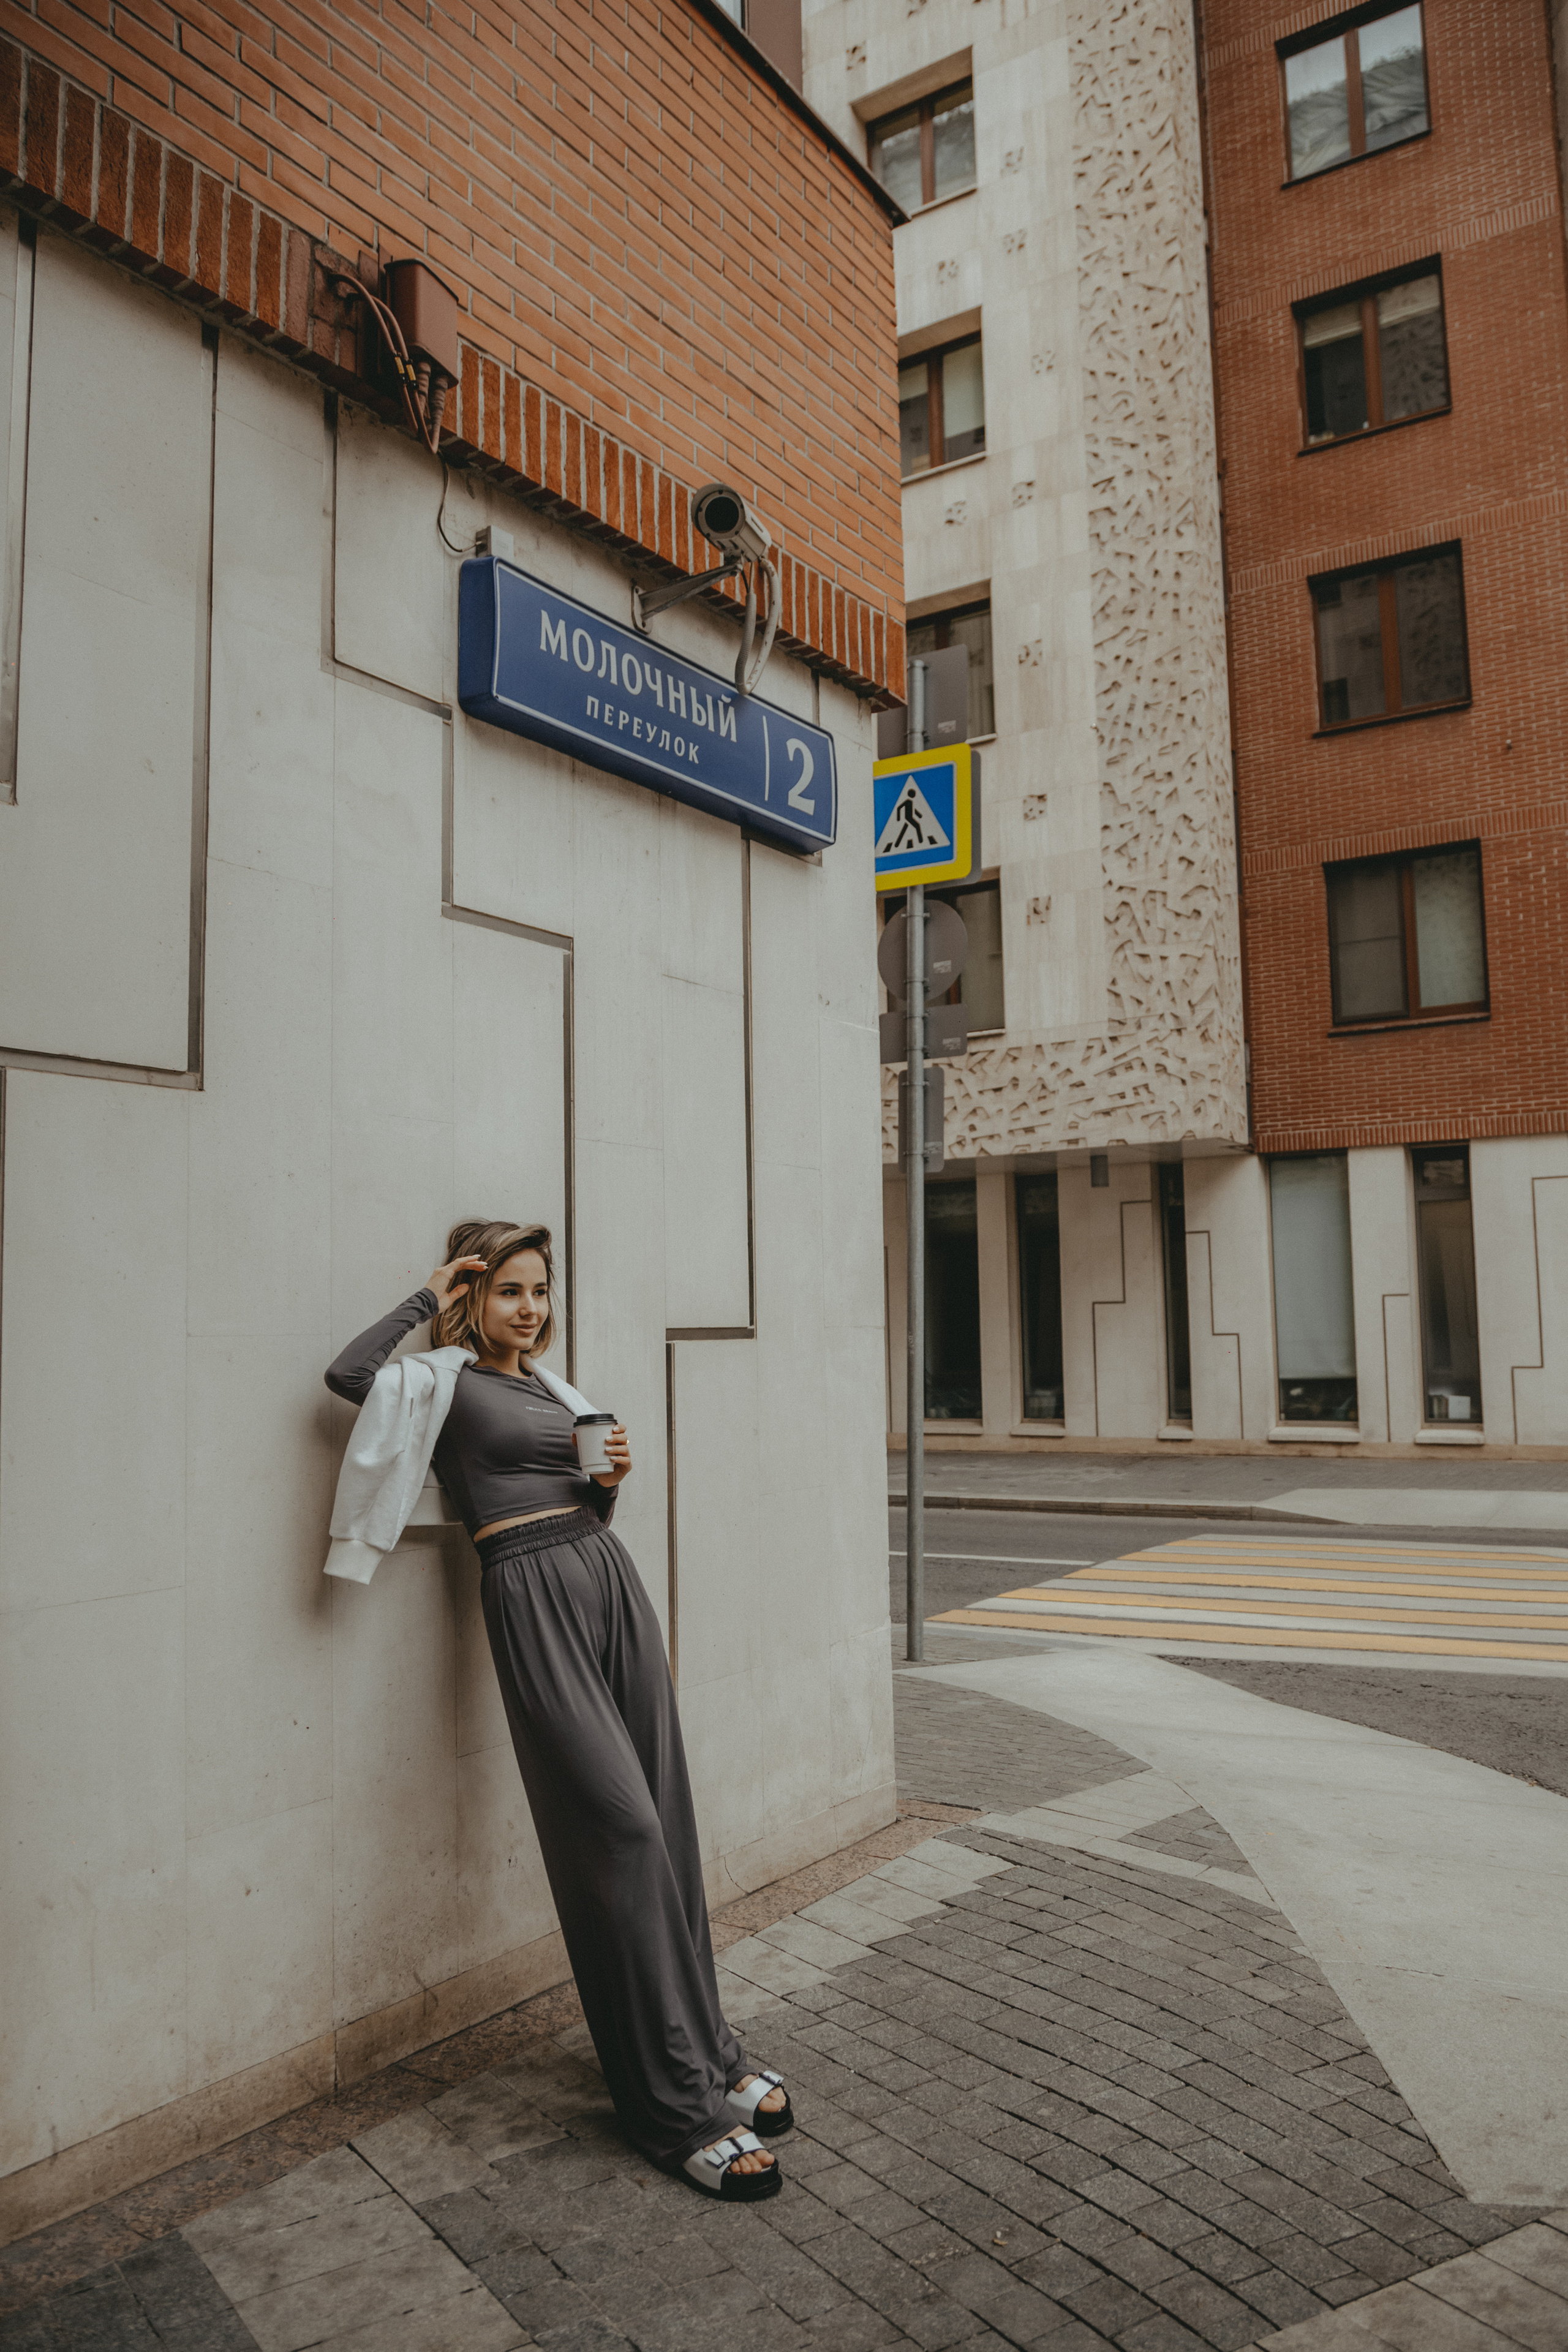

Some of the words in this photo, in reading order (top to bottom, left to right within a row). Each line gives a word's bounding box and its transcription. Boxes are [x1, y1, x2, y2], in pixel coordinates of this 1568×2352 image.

[540, 609, 737, 743] МОЛОЧНЫЙ
[586, 695, 699, 764] ПЕРЕУЛОК
[786, 737, 816, 816] 2
